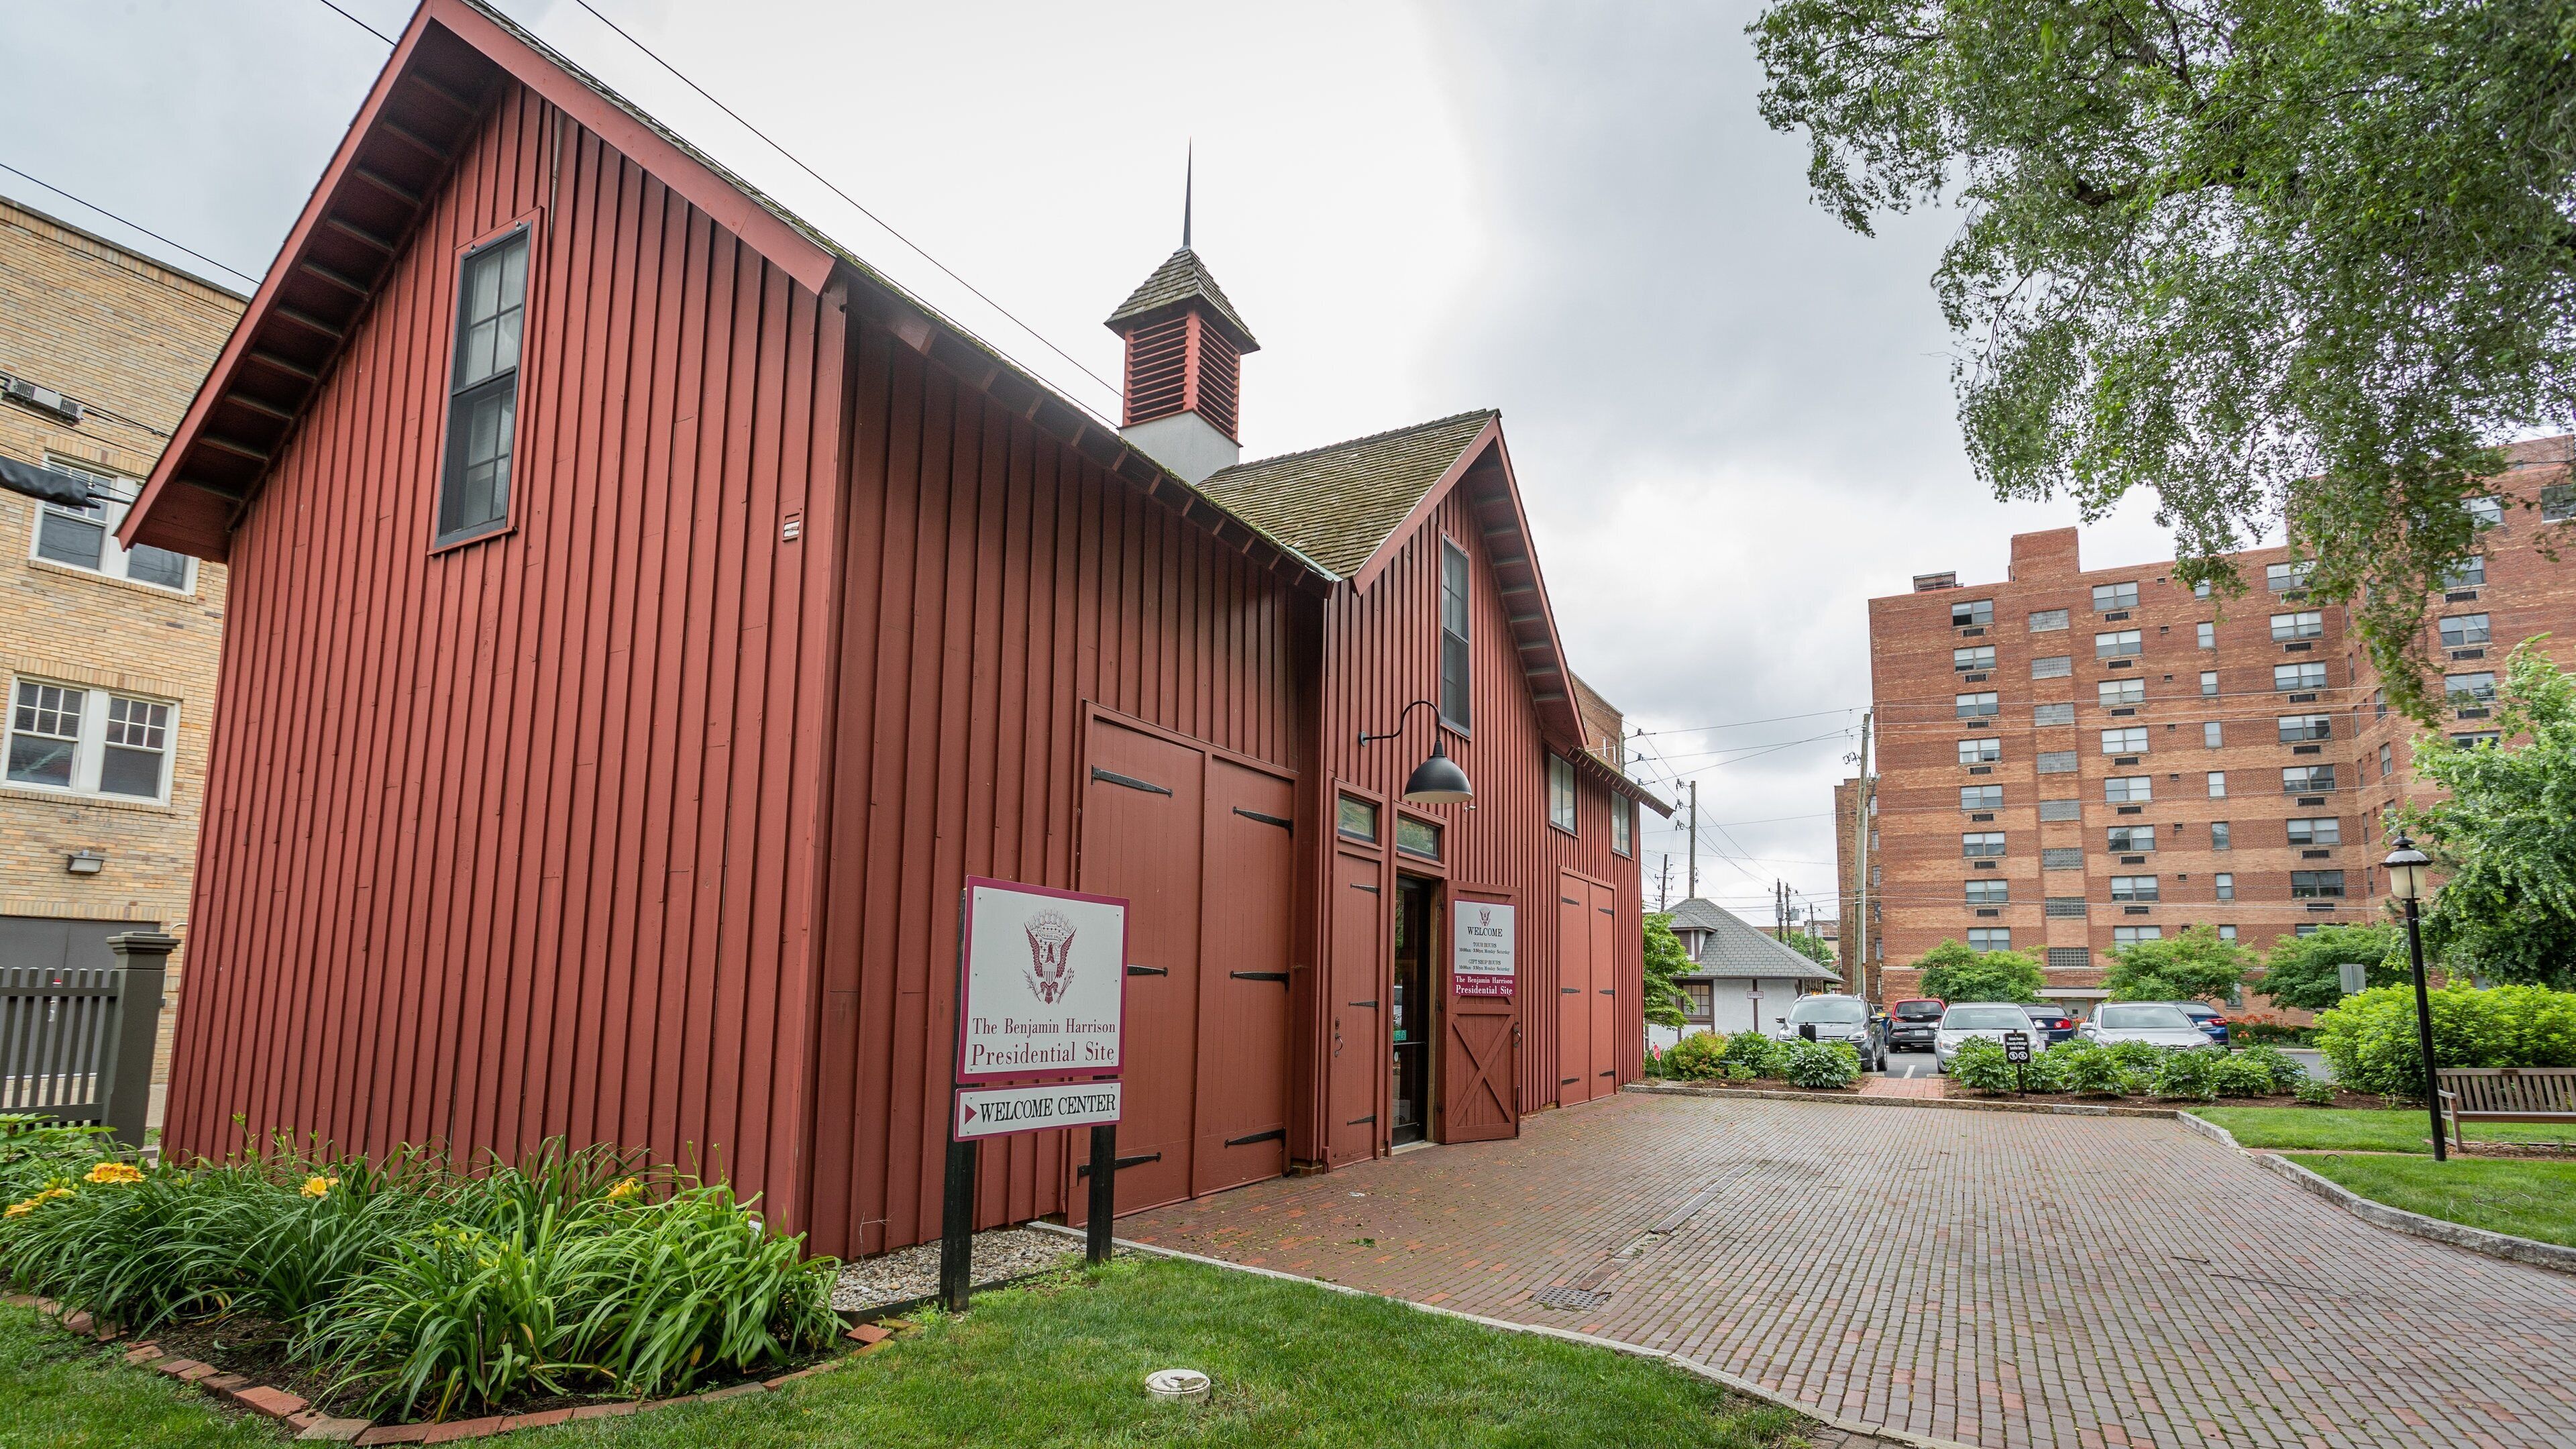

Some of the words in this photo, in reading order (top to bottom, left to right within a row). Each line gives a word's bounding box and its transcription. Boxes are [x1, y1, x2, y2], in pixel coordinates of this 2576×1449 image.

[1467, 926, 1503, 937] WELCOME
[1467, 976, 1490, 985] Benjamin
[1456, 984, 1497, 994] Presidential
[1500, 985, 1513, 994] Site
[972, 1018, 998, 1034] The
[1004, 1018, 1059, 1038] Benjamin
[1065, 1018, 1116, 1033] Harrison
[970, 1041, 1075, 1066] Presidential
[1085, 1040, 1114, 1061] Site
[980, 1097, 1053, 1123] WELCOME
[1058, 1093, 1116, 1116] CENTER
